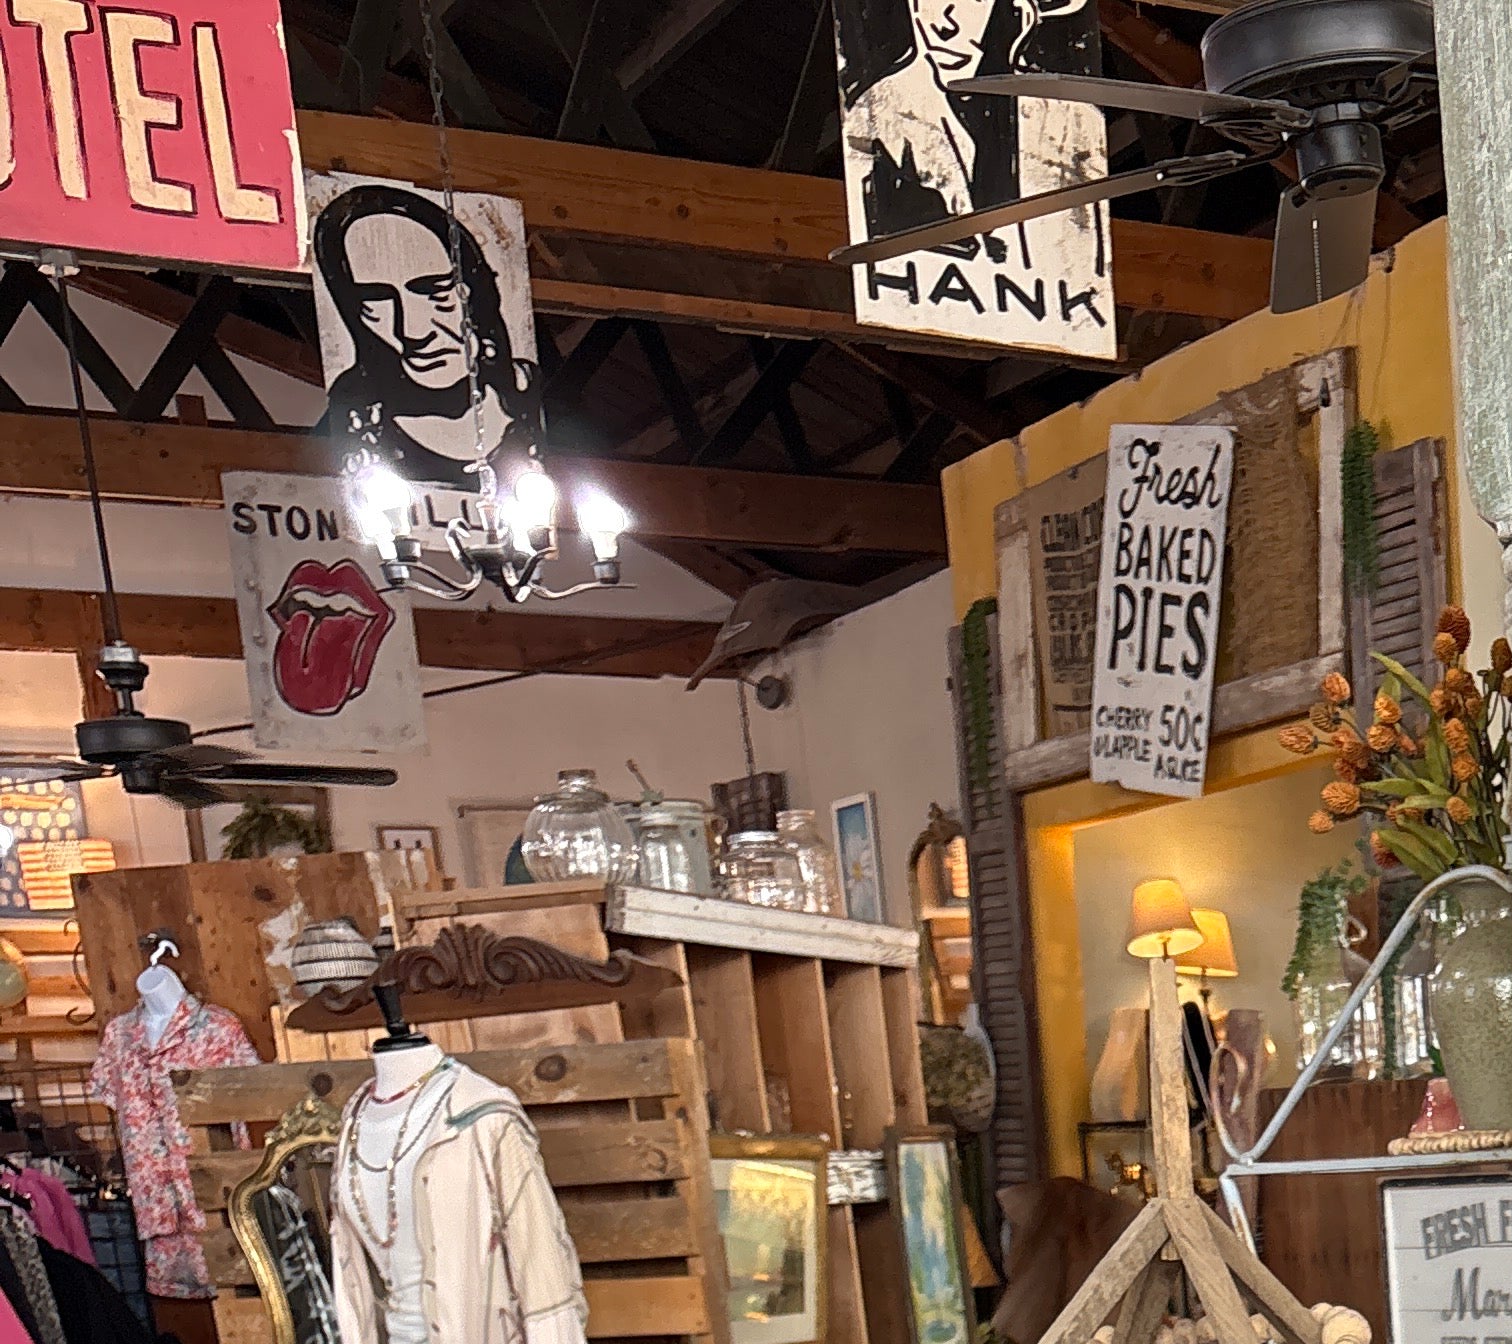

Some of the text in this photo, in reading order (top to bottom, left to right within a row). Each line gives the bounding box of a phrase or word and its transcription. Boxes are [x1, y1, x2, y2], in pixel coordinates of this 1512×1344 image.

[0, 0, 284, 224] TEL
[867, 258, 1107, 328] HANK
[1118, 437, 1223, 519] Fresh
[232, 502, 340, 542] STON
[1113, 522, 1217, 585] BAKED
[1106, 583, 1211, 680] PIES
[1420, 1202, 1488, 1260] FRESH
